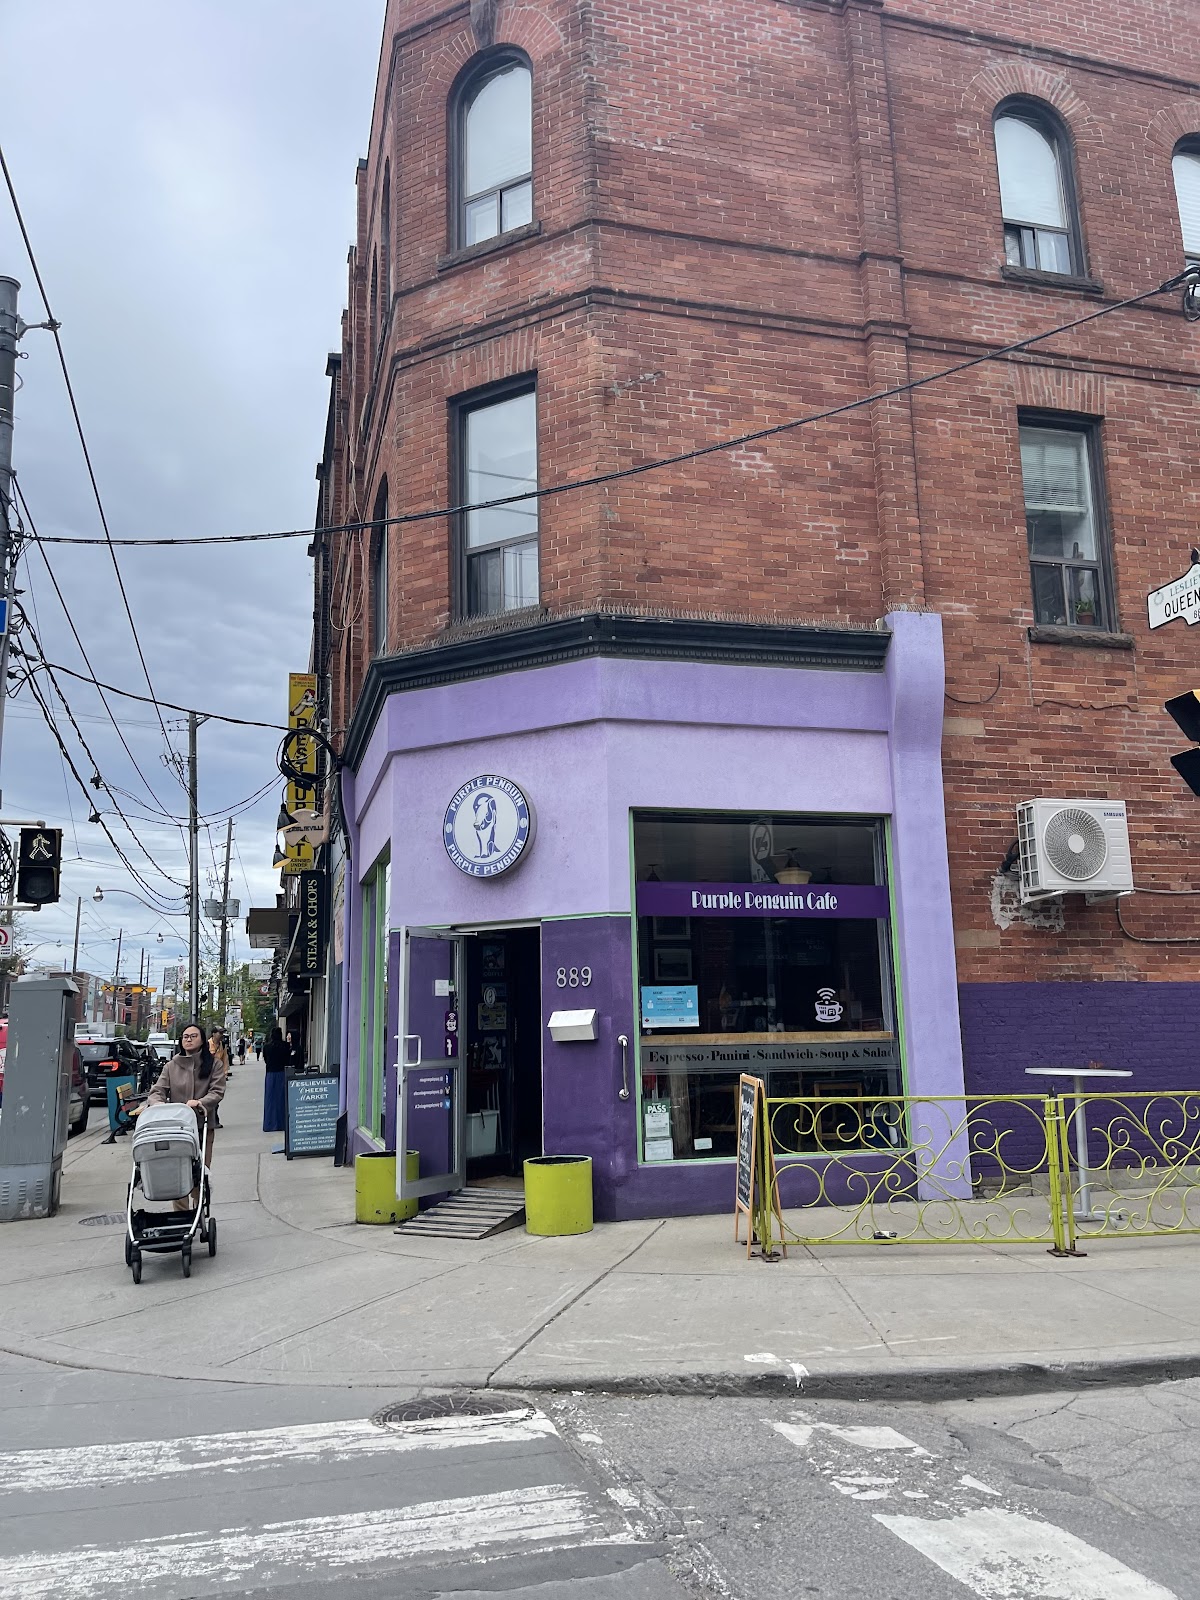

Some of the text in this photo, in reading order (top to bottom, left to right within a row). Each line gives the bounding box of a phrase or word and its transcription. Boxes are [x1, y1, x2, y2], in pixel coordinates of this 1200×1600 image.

[1170, 574, 1200, 597] LESLIE
[1164, 587, 1200, 618] QUEEN
[450, 777, 524, 812] PURPLE PENGUIN
[448, 838, 524, 875] PURPLE PENGUIN
[691, 890, 838, 910] Purple Penguin Cafe
[306, 879, 318, 969] STEAK & CHOPS
[556, 966, 592, 988] 889
[649, 1046, 894, 1065] Espresso Panini Sandwich Soup & Salad
[290, 1079, 337, 1088] LESLIEVILLE
[299, 1086, 328, 1094] CHEESE
[297, 1093, 329, 1101] MARKET
[647, 1105, 667, 1114] PASS
